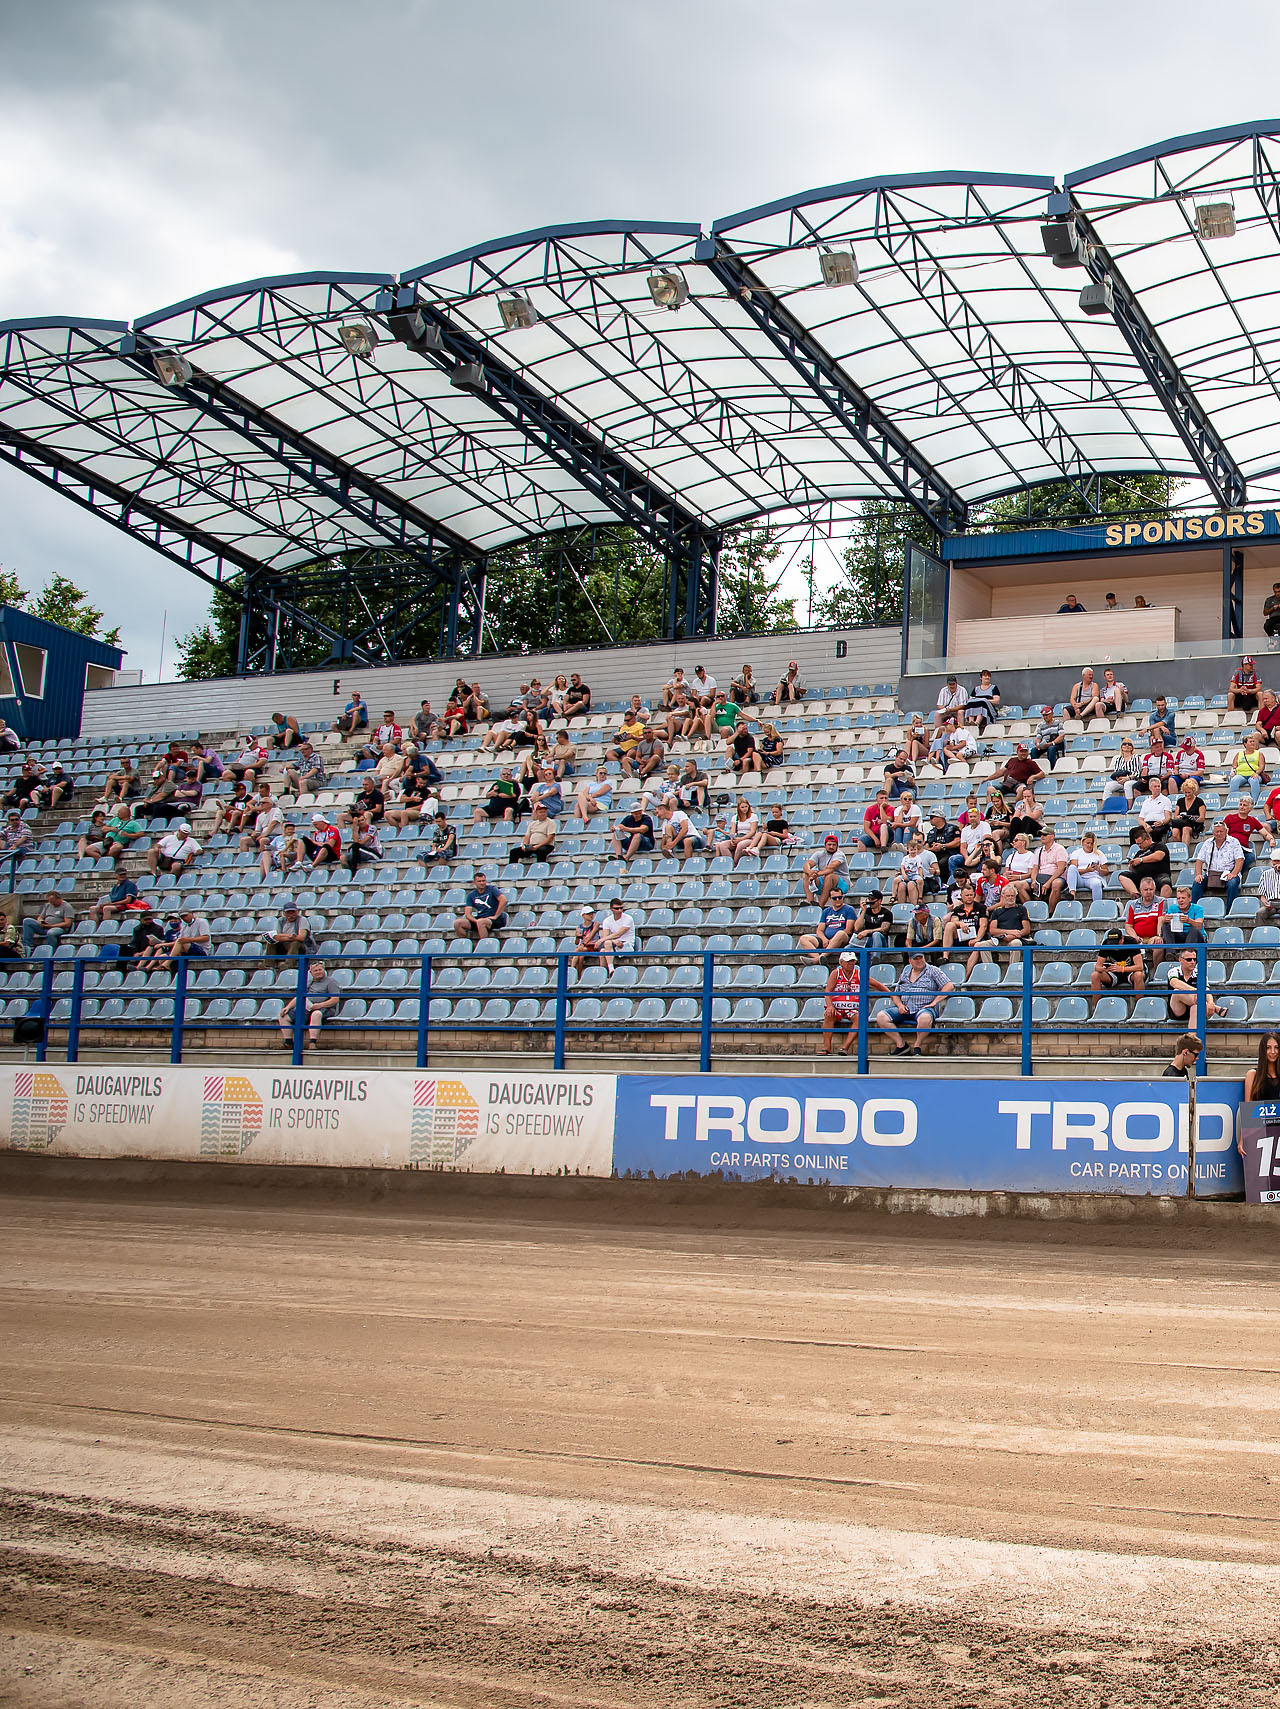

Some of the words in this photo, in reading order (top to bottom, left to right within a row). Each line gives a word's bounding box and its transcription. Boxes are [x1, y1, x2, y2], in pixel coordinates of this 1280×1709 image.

[1105, 512, 1264, 546] SPONSORS
[836, 640, 847, 658] D
[333, 679, 341, 695] E
[76, 1075, 162, 1097] DAUGAVPILS
[271, 1079, 367, 1101] DAUGAVPILS
[488, 1083, 594, 1106] DAUGAVPILS
[73, 1103, 85, 1122] IS
[89, 1103, 155, 1125] SPEEDWAY
[268, 1107, 282, 1129] IR
[286, 1108, 340, 1130] SPORTS
[650, 1095, 918, 1147] TRODO
[1259, 1104, 1277, 1116] 2LŻ
[486, 1113, 500, 1135] IS
[505, 1113, 584, 1137] SPEEDWAY
[710, 1151, 742, 1167] CAR
[744, 1152, 790, 1169] PARTS
[794, 1154, 849, 1170] ONLINE
[1070, 1161, 1104, 1177] CAR
[1108, 1162, 1163, 1179] PARTS
[1167, 1163, 1226, 1179] ONLINE
